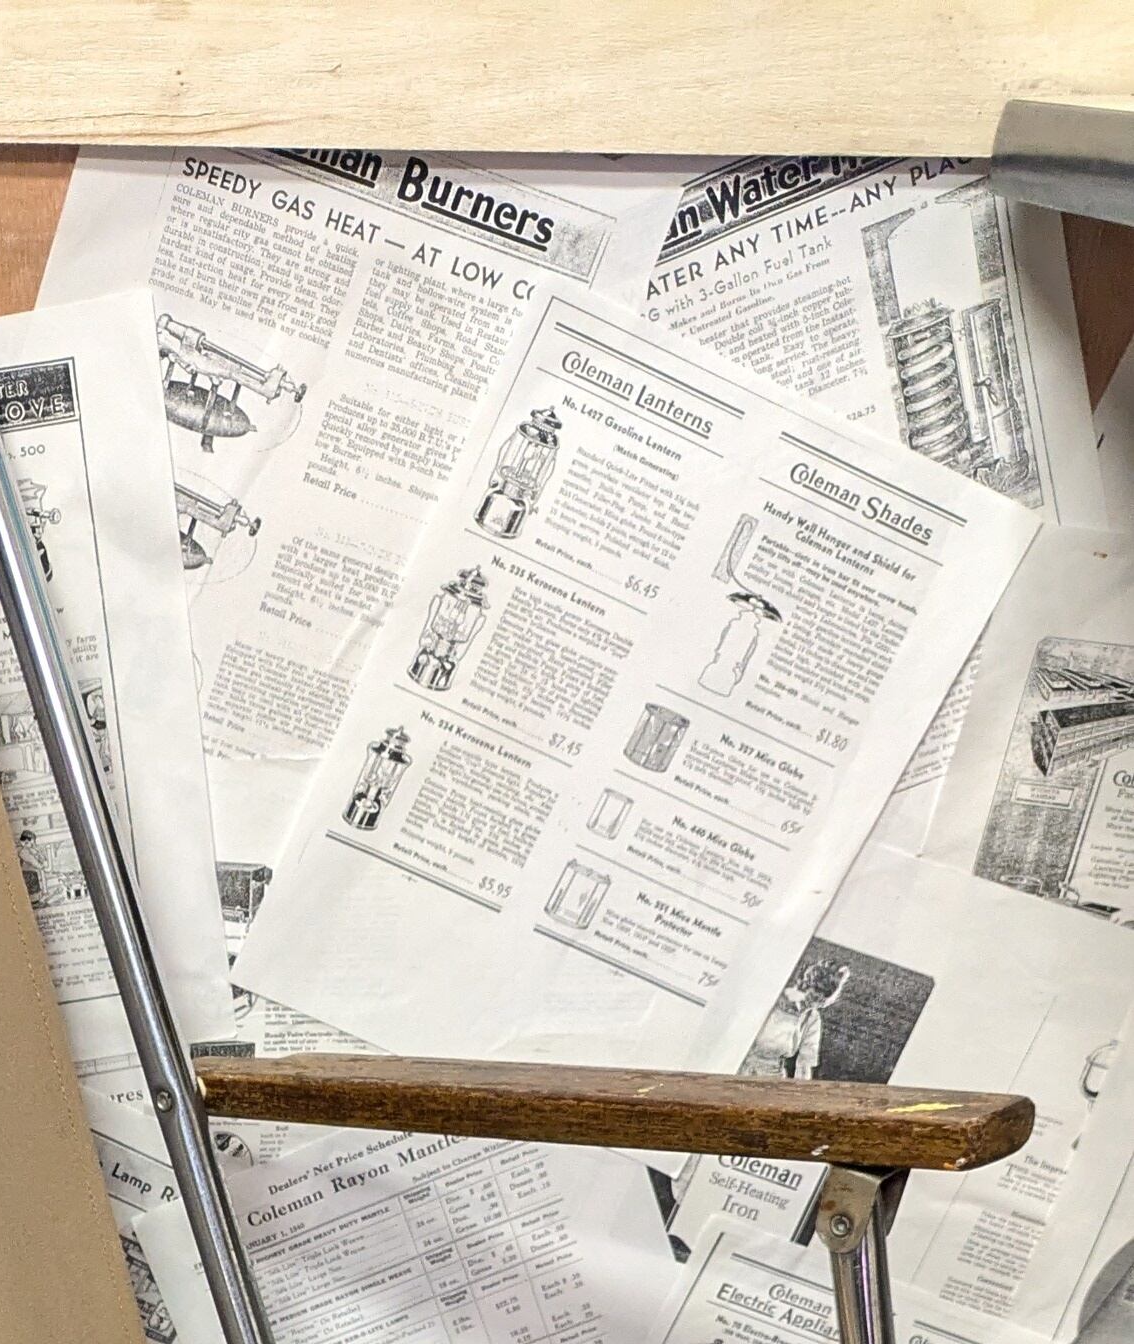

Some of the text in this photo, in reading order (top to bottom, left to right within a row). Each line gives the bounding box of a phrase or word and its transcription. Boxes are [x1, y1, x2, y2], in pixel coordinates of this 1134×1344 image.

[397, 156, 555, 246] Burners
[706, 155, 828, 224] Water
[172, 195, 357, 269] sure and dependable method of heating
[176, 183, 225, 206] COLEMAN
[231, 202, 279, 227] BURNERS
[284, 224, 317, 242] provide
[183, 157, 262, 199] SPEEDY
[272, 190, 315, 220] GAS
[325, 208, 381, 244] HEAT
[411, 243, 442, 267] AT
[450, 256, 503, 289] LOW
[646, 261, 705, 301] ATER
[715, 234, 759, 271] ANY
[906, 156, 971, 187] PLA
[260, 246, 282, 264] They
[334, 277, 352, 287] and
[665, 235, 832, 315] with 3-Gallon Fuel Tank
[700, 304, 716, 318] and
[786, 270, 803, 280] Gas
[805, 258, 830, 273] From
[689, 296, 775, 335] Untreated Gasoline.
[699, 275, 851, 346] heater that provides steaming-hot
[711, 330, 745, 350] Double
[748, 322, 764, 336] coil
[802, 296, 831, 313] copper
[725, 317, 800, 355] and heated with
[345, 349, 385, 368] numerous
[387, 358, 451, 393] manufacturing
[562, 351, 713, 433] Coleman Lanterns
[562, 395, 681, 461] No. L427 Gasoline Lantern
[20, 444, 46, 458] 500
[616, 445, 679, 481] (Match Generating)
[303, 472, 357, 500] Retail Price
[790, 463, 932, 545] Coleman Shades
[763, 501, 916, 581] Handy Wall Hanger and Shield for
[795, 530, 874, 576] Coleman Lanterns
[491, 555, 506, 570] No.
[526, 571, 568, 598] Kerosene
[570, 592, 605, 616] Lantern
[625, 575, 660, 599] $6.45
[420, 710, 531, 768] No. Kerosene Lantern
[720, 734, 804, 780] No. Mica Globe
[815, 725, 849, 753] $1.80
[672, 816, 755, 861] No. Mica Globe
[478, 876, 512, 898] $5.95
[636, 892, 651, 906] No.
[670, 908, 690, 923] Mica
[654, 914, 692, 936] Protector
[111, 1162, 152, 1195] Lamp
[247, 1131, 471, 1227] Coleman Rayon Mantle
[268, 1170, 309, 1195] Dealers'
[313, 1162, 334, 1176] Net
[335, 1151, 364, 1167] Price
[709, 1171, 790, 1210] Self-Heating
[718, 1154, 803, 1188] Coleman
[721, 1194, 759, 1221] Iron
[716, 1283, 778, 1317] Electric
[768, 1283, 836, 1315] Coleman
